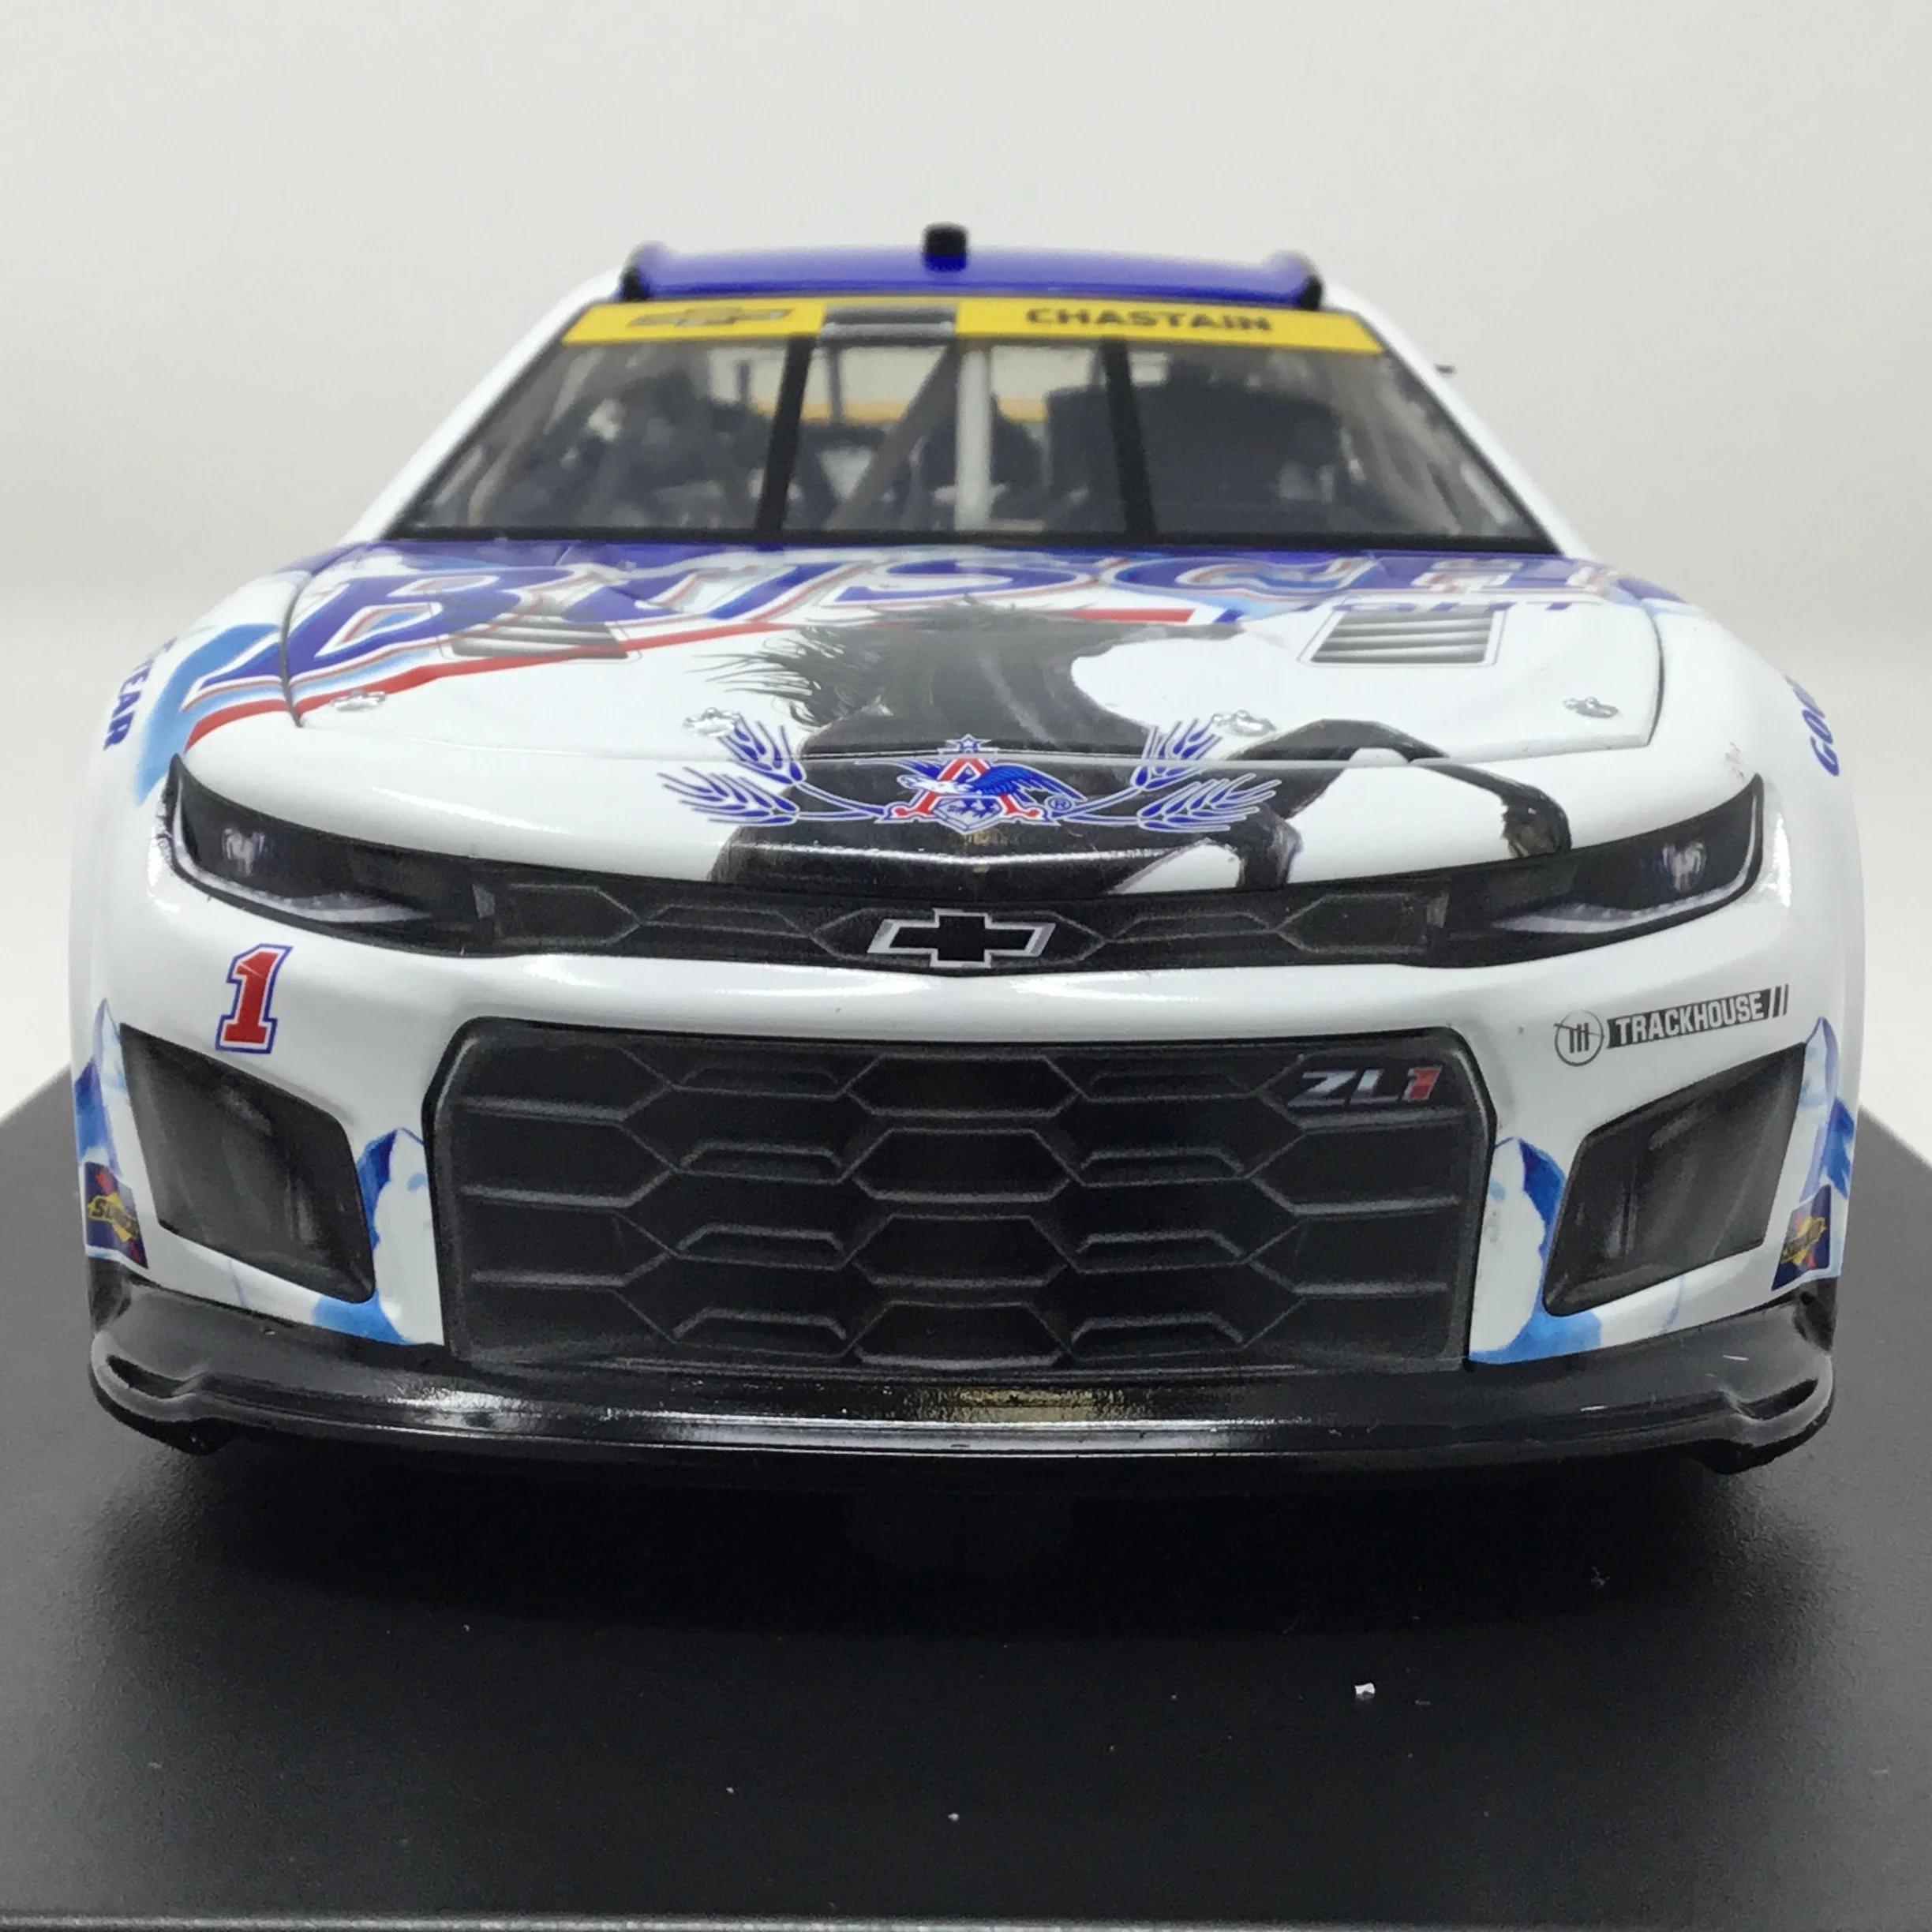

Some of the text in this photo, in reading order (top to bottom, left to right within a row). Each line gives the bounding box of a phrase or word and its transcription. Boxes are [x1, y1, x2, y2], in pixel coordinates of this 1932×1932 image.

[1025, 308, 1273, 331] CHASTAIN
[103, 657, 155, 751] EAR
[215, 943, 294, 1054] 1
[1615, 992, 1765, 1046] TRACKHOUSE
[1286, 1065, 1443, 1106] ZL1
